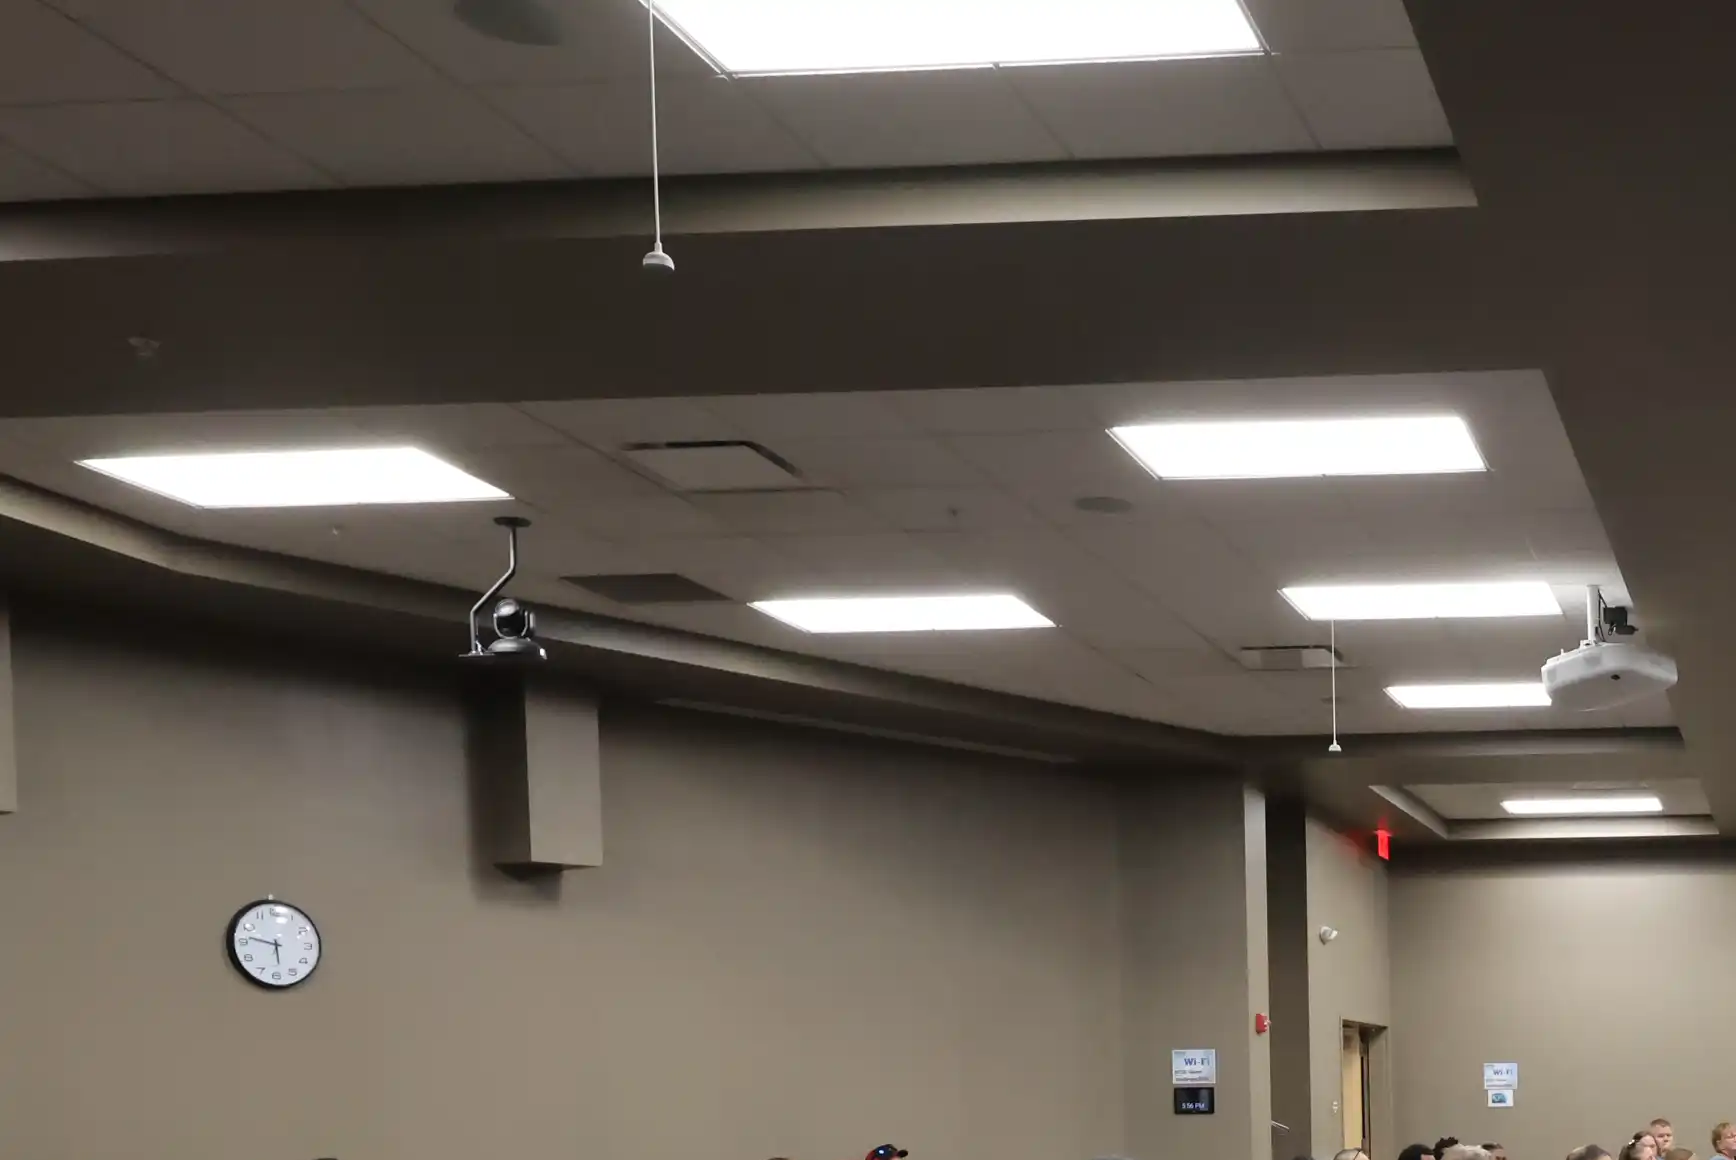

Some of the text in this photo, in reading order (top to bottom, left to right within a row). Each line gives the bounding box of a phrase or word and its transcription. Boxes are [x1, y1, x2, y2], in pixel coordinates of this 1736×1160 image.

[256, 910, 264, 920] 11
[238, 938, 248, 946] 9
[303, 942, 312, 951] 3
[244, 953, 253, 962] 8
[298, 957, 309, 965] 4
[255, 966, 266, 975] 7
[288, 968, 298, 977] 5
[271, 971, 282, 980] 6
